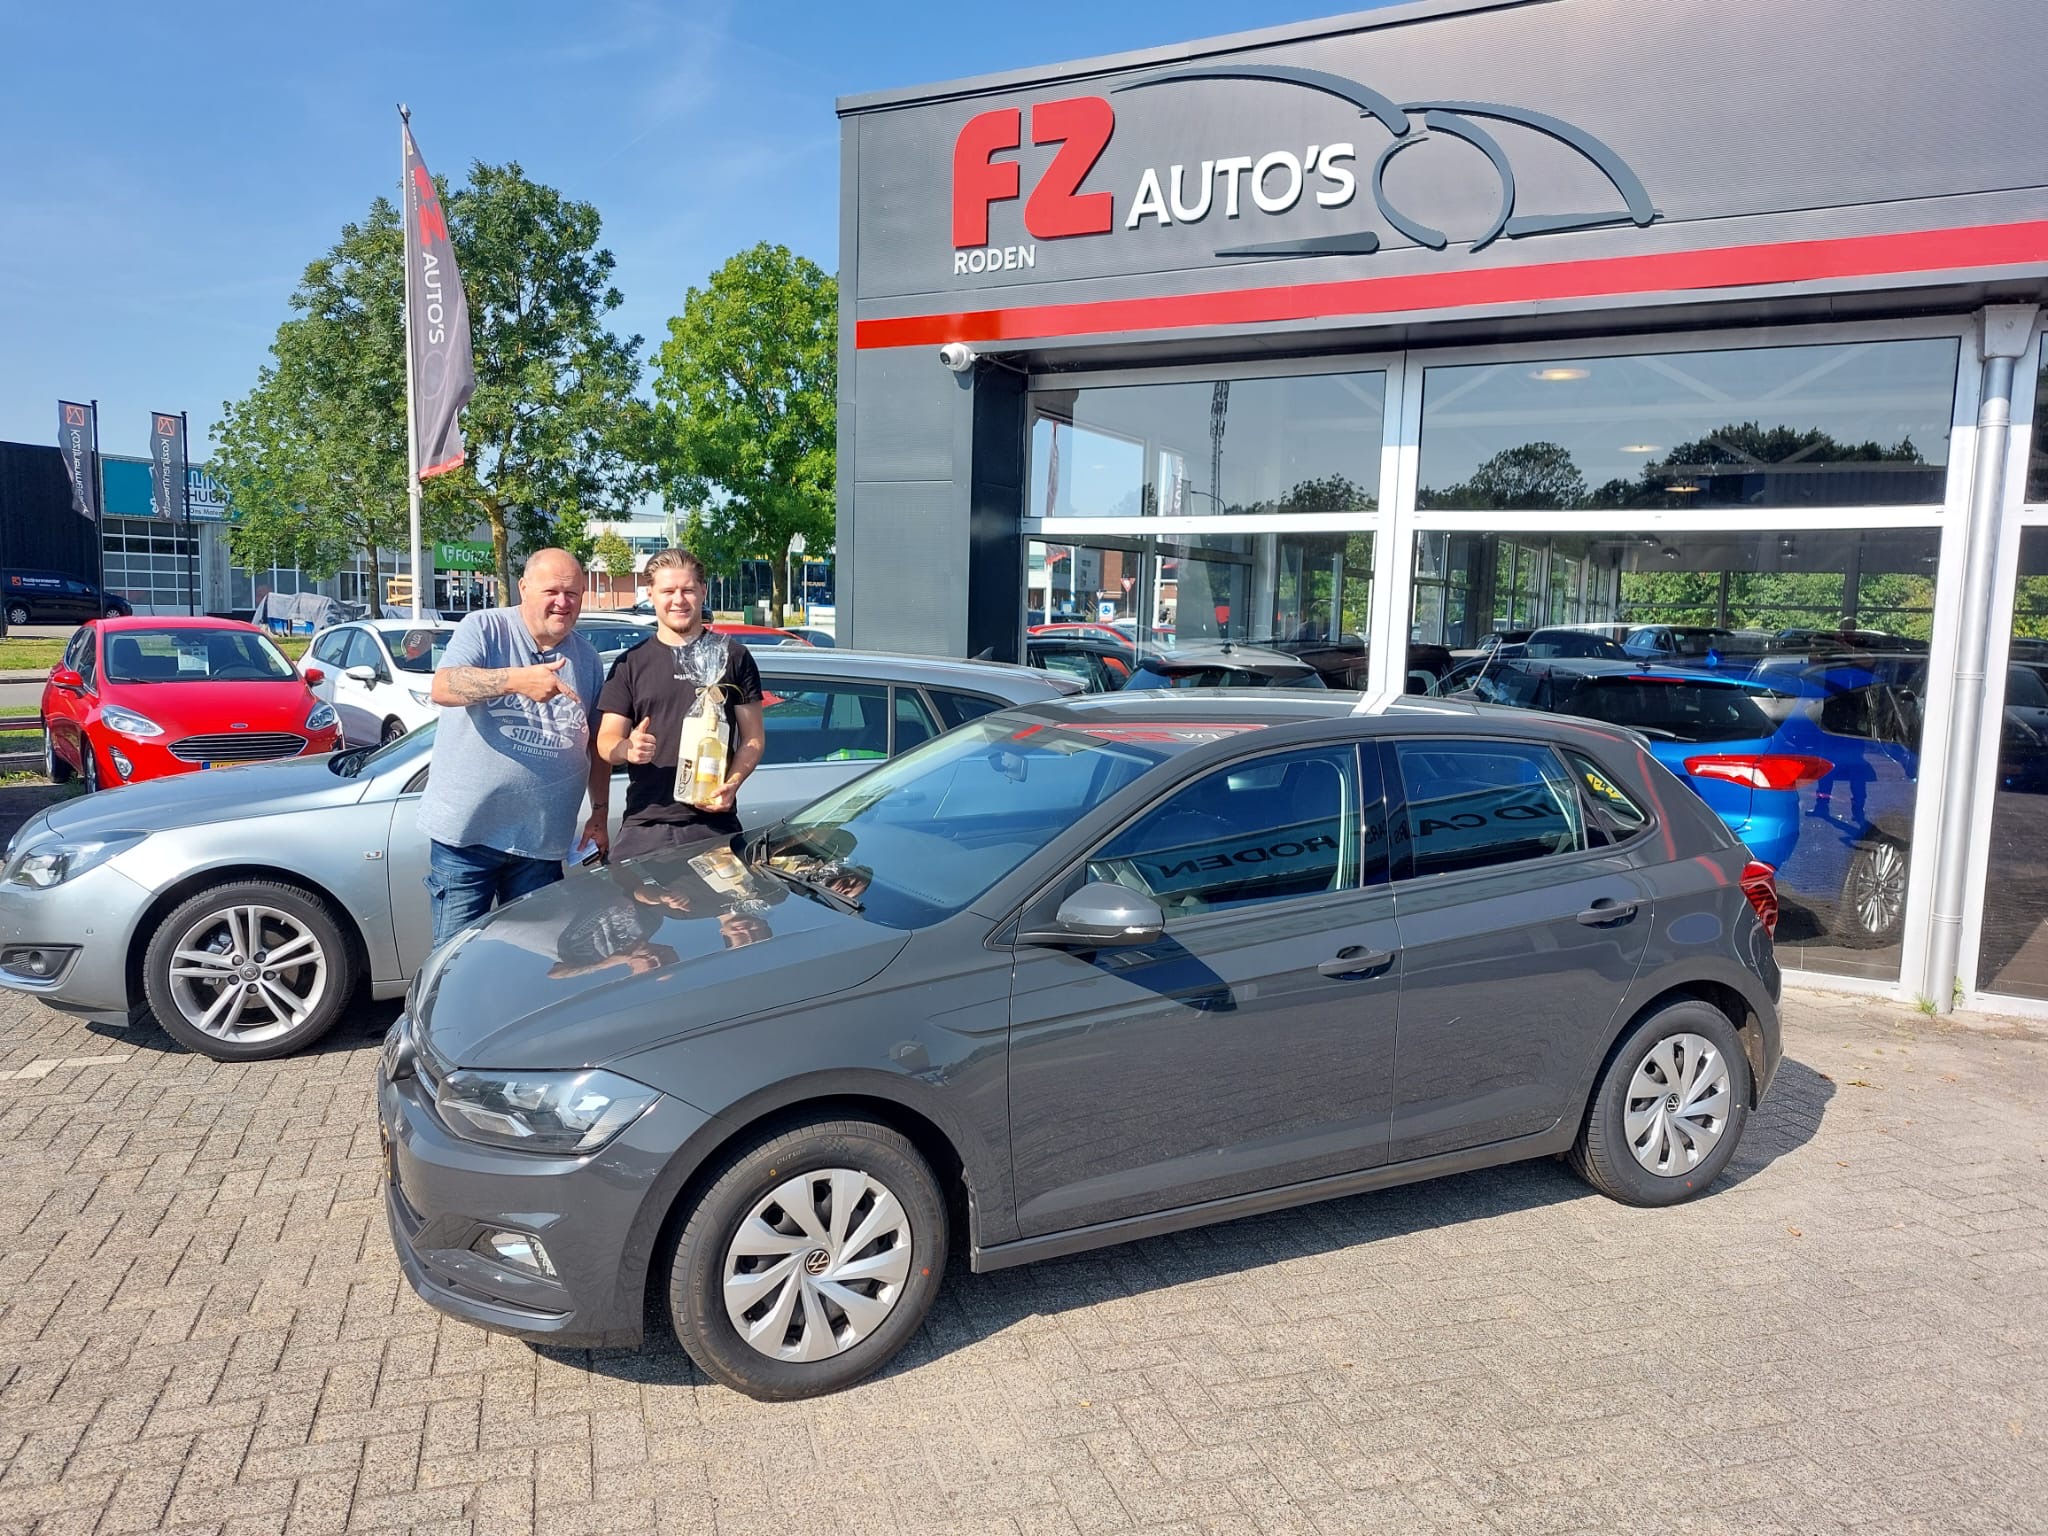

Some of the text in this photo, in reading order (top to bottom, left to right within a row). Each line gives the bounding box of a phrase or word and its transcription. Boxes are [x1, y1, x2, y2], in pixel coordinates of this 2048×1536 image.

[952, 96, 1357, 248] FZ AUTO'S
[422, 251, 445, 344] AUTO'S
[953, 245, 1037, 275] RODEN
